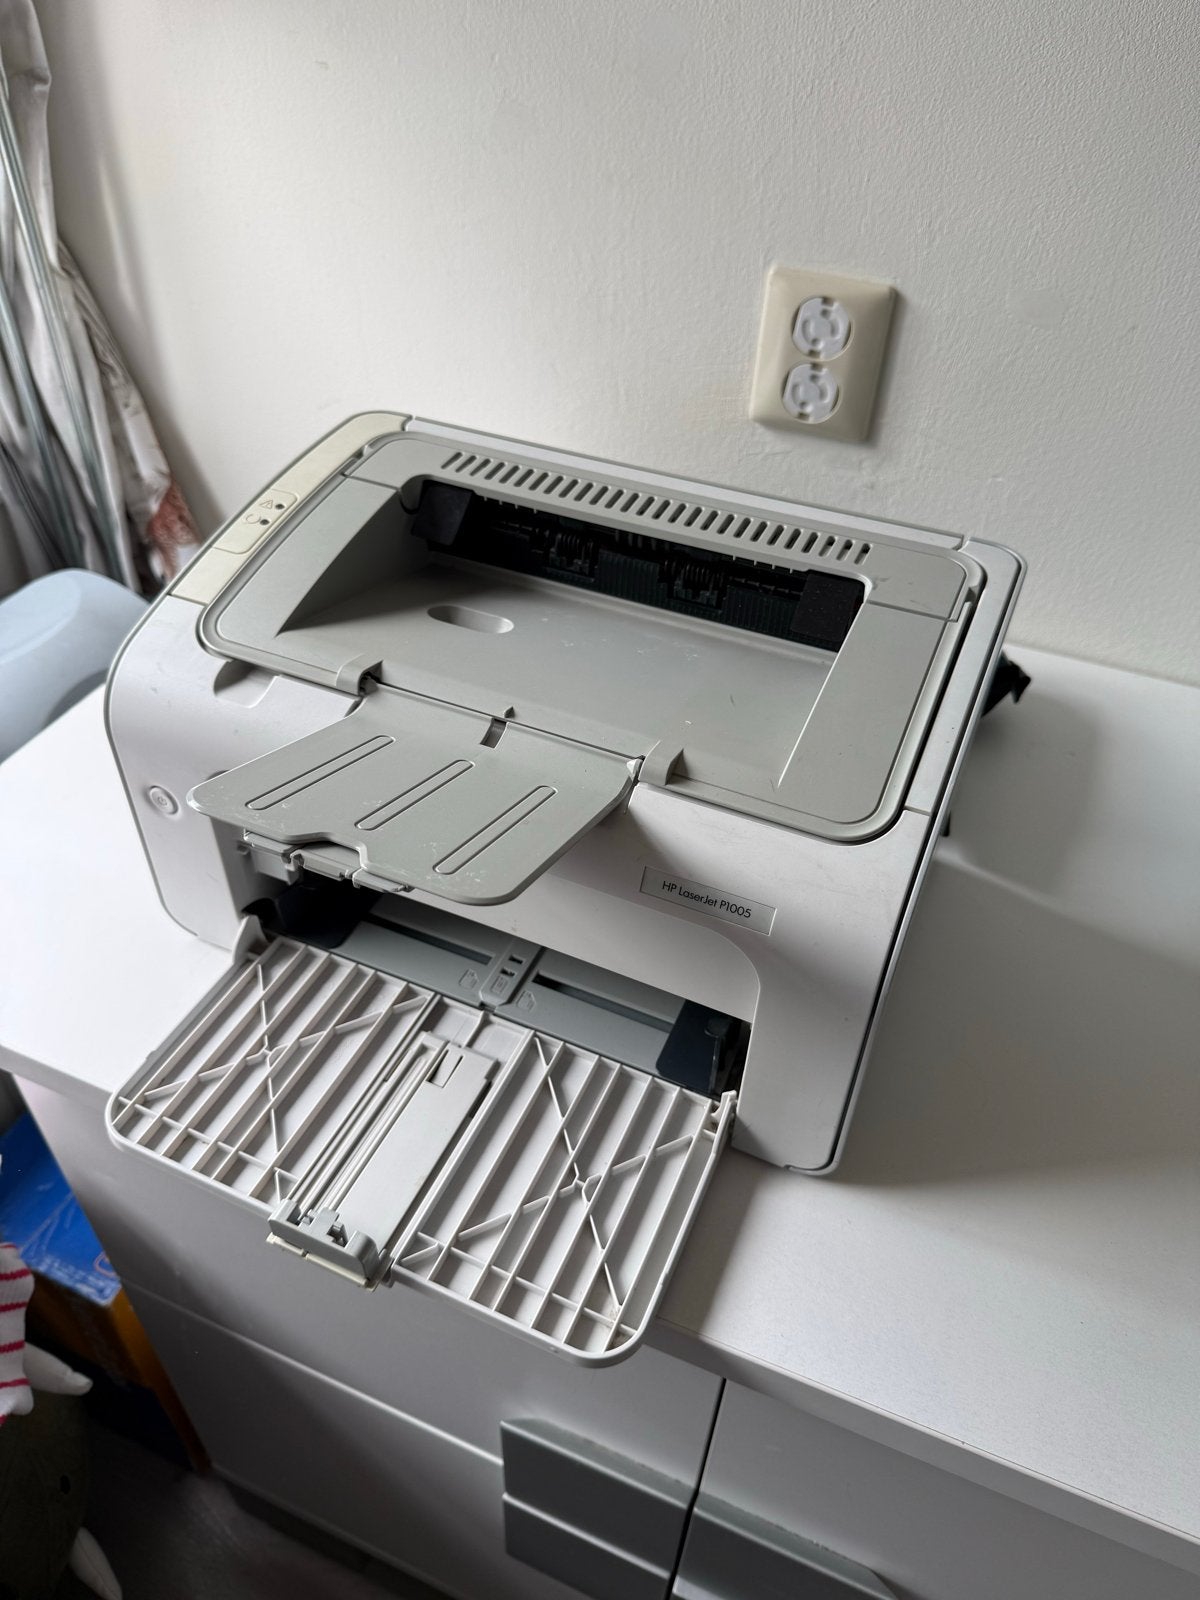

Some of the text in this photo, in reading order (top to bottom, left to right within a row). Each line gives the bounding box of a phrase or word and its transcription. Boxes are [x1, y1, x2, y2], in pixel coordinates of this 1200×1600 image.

[662, 880, 752, 918] HP LaserJet P1005
